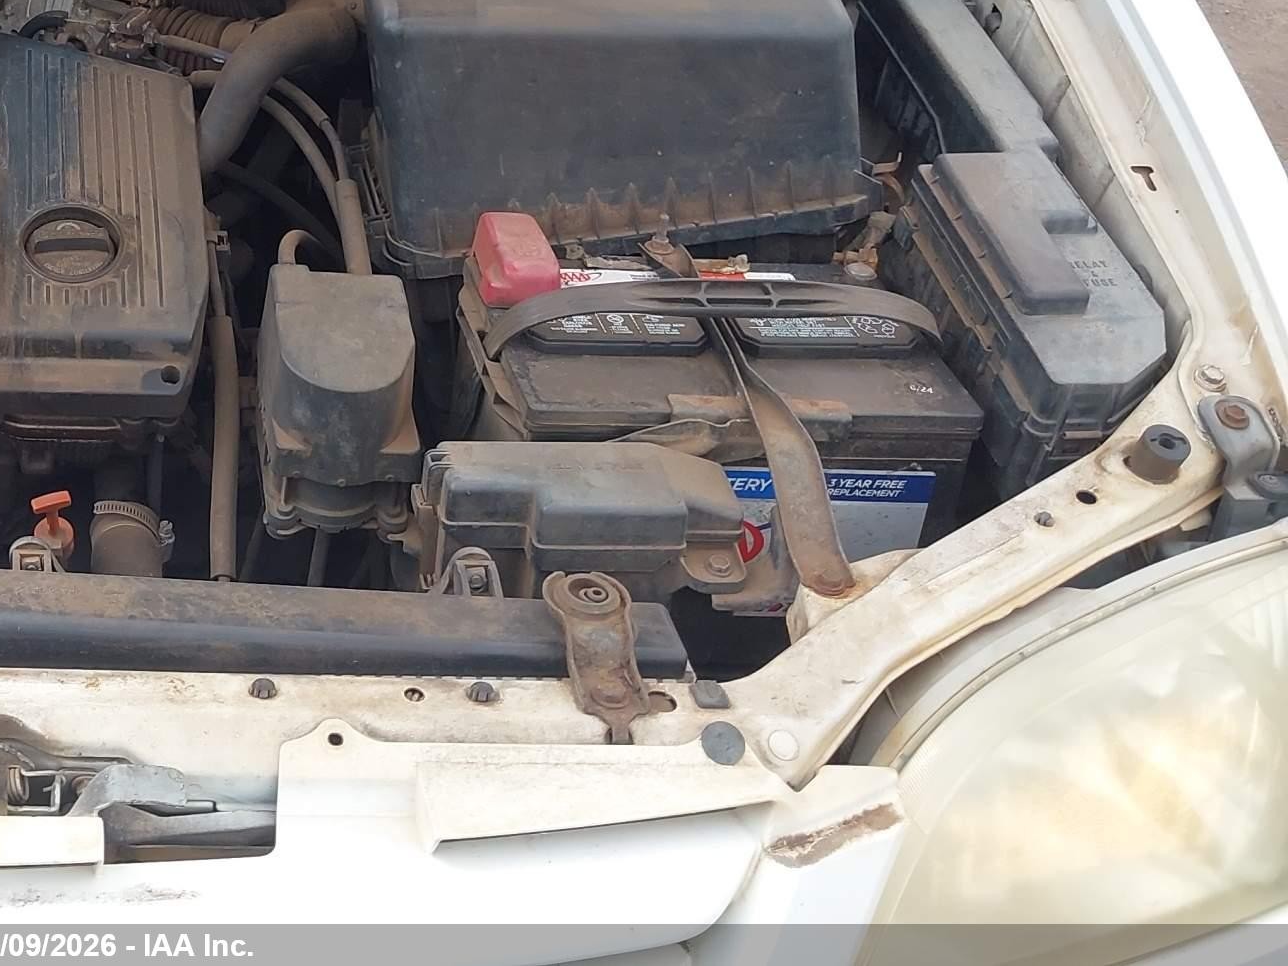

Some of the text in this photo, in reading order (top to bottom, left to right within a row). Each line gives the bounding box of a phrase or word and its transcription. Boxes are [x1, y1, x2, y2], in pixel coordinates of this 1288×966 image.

[728, 477, 772, 492] TERY
[828, 478, 908, 490] 3 YEAR FREE
